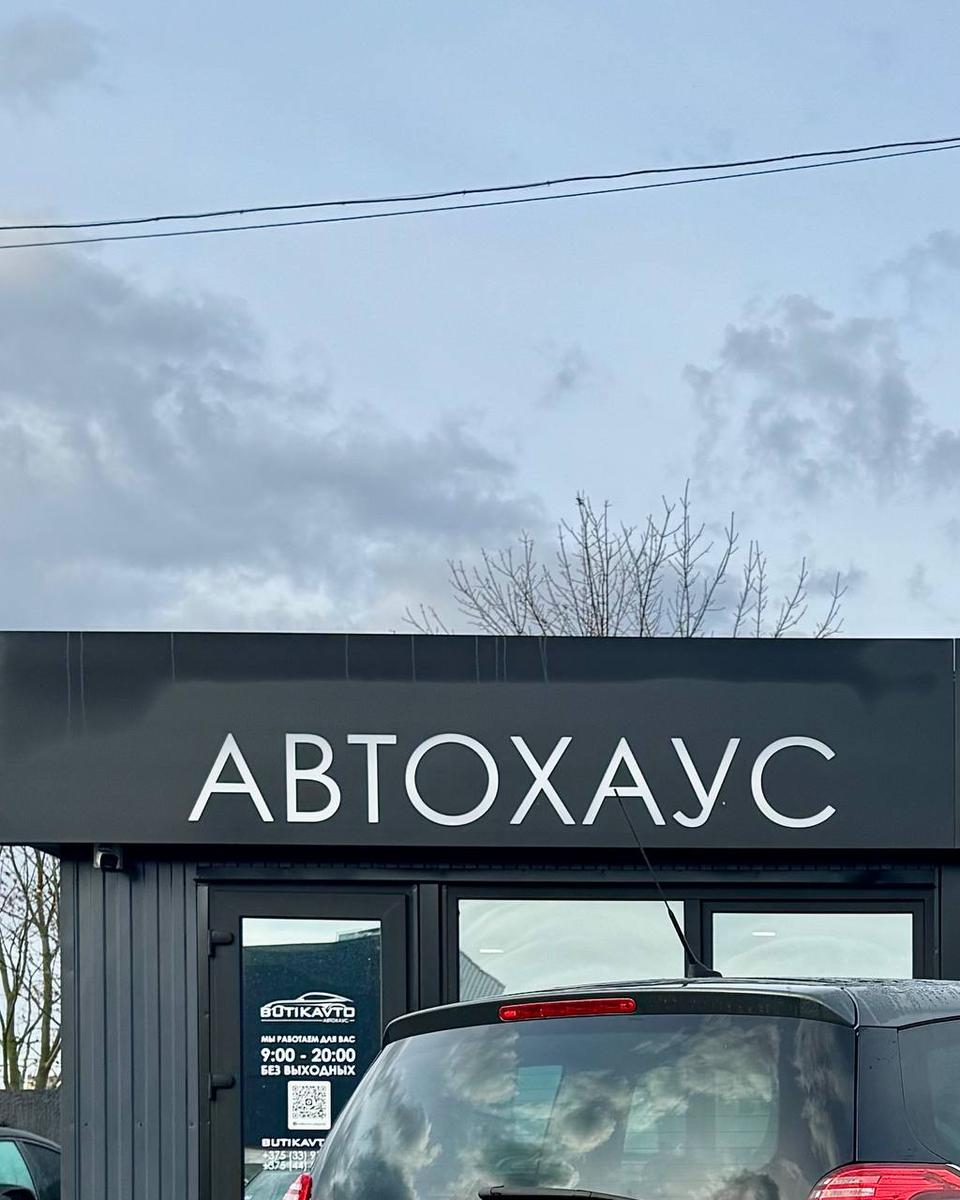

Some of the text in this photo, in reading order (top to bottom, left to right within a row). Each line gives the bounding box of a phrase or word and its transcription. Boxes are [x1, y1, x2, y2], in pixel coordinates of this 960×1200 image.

[189, 732, 837, 828] АВТОХАУС
[260, 1006, 355, 1018] BUTIKAVTO
[261, 1035, 356, 1043] МЫ РАБОТАЕМ ДЛЯ ВАС
[260, 1048, 296, 1062] 9:00
[311, 1047, 356, 1062] 20:00
[260, 1065, 356, 1076] БЕЗ ВЫХОДНЫХ
[261, 1138, 325, 1147] BUTIKAVT
[289, 1150, 307, 1161] (33)
